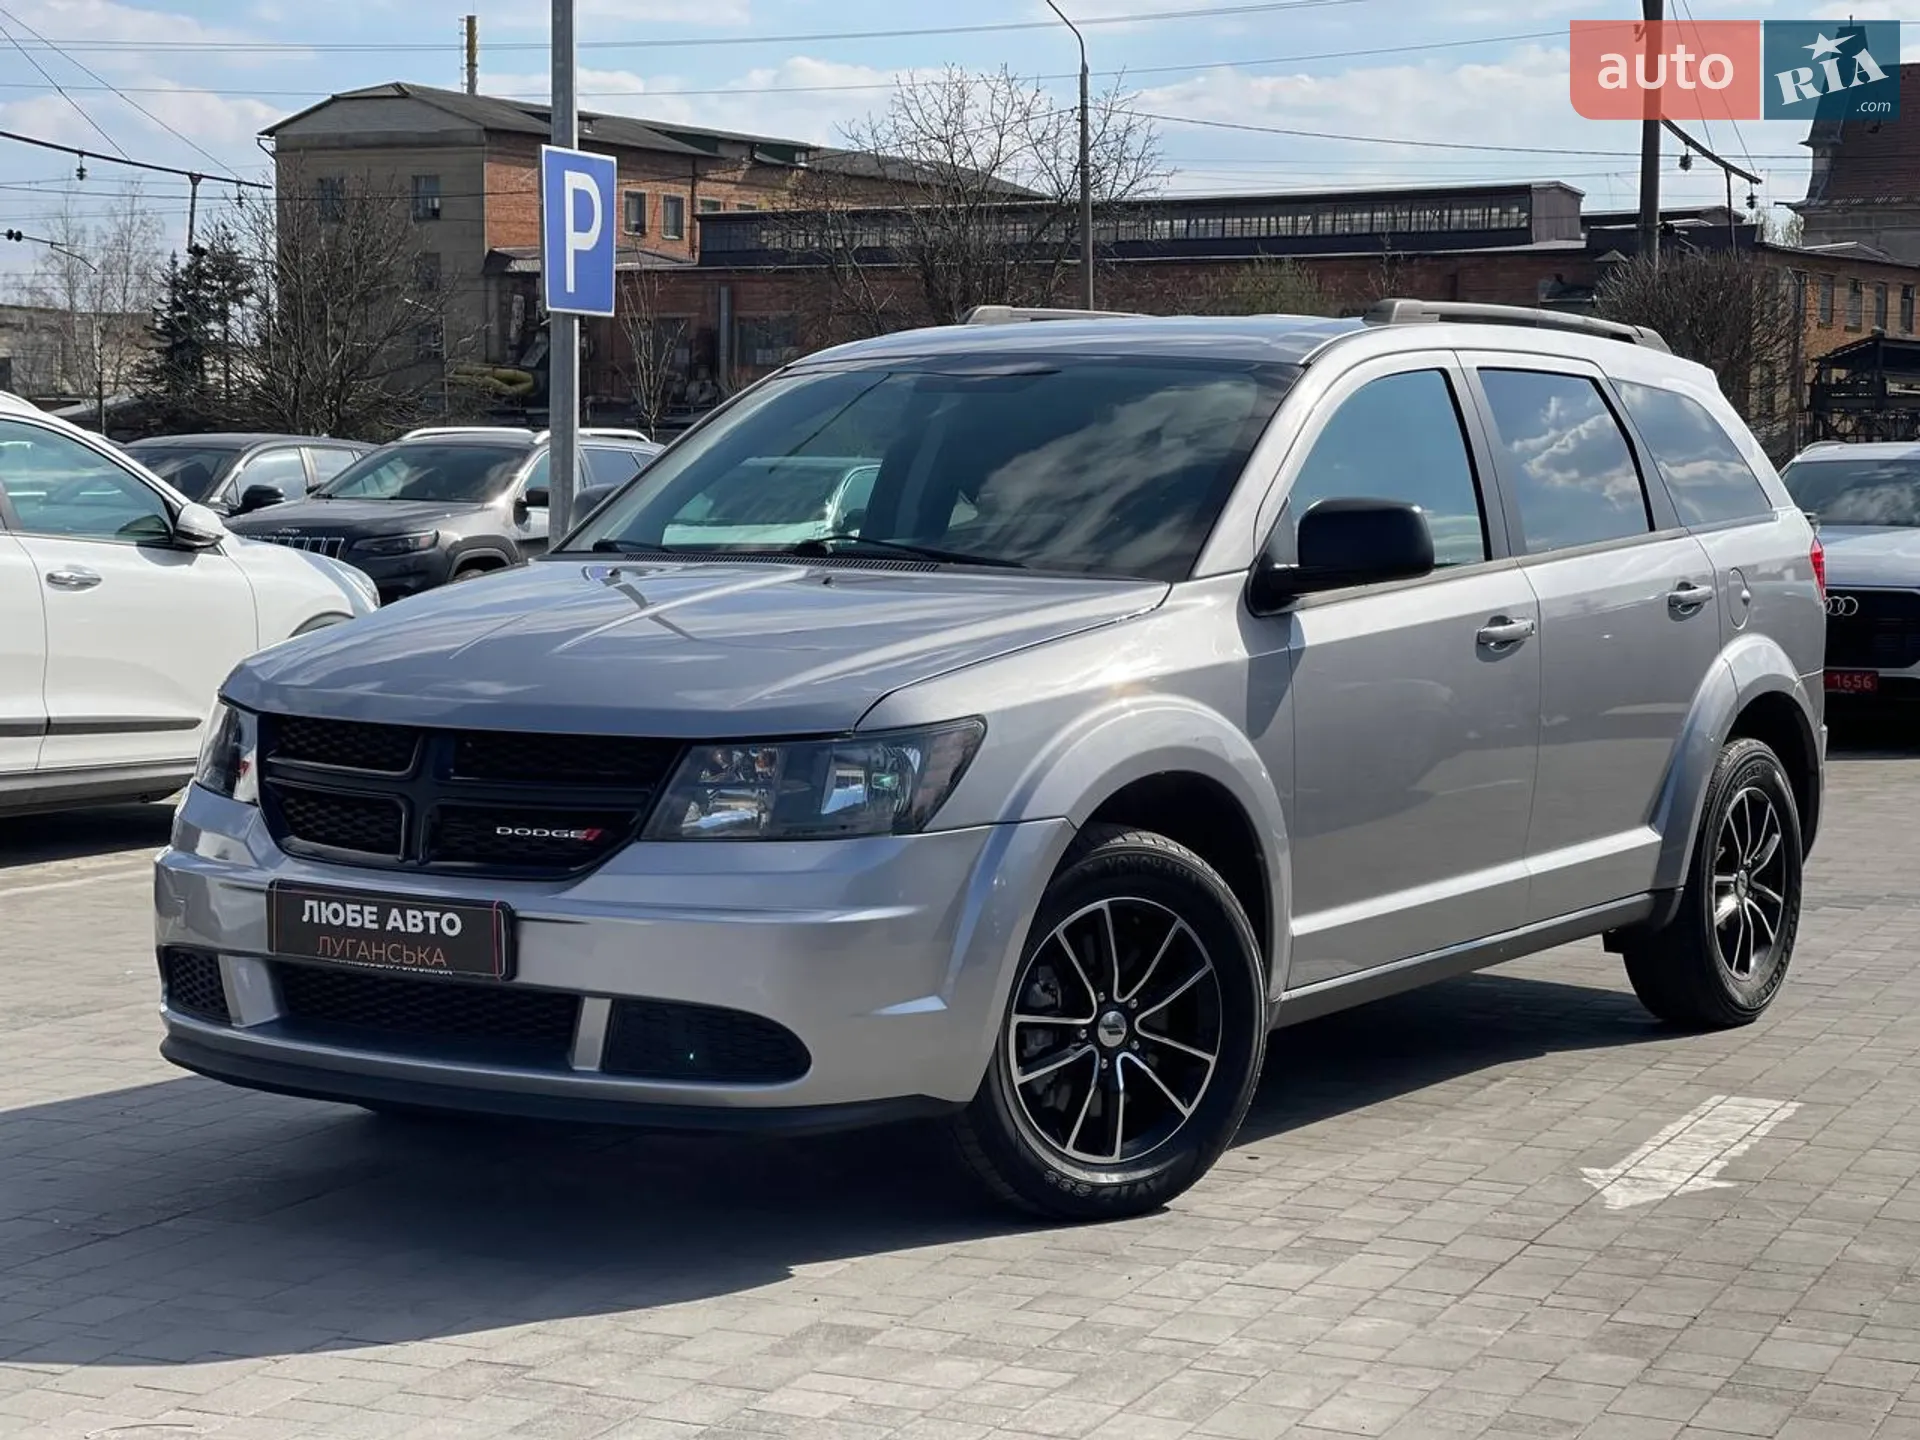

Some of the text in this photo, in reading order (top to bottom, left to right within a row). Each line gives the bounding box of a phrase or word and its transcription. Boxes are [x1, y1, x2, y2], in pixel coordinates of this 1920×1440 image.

[564, 170, 602, 293] P
[1834, 674, 1872, 689] 1656
[496, 826, 587, 839] DODGE
[302, 900, 462, 937] ЛЮБЕ АВТО
[316, 935, 447, 967] ЛУГАНСЬКА
